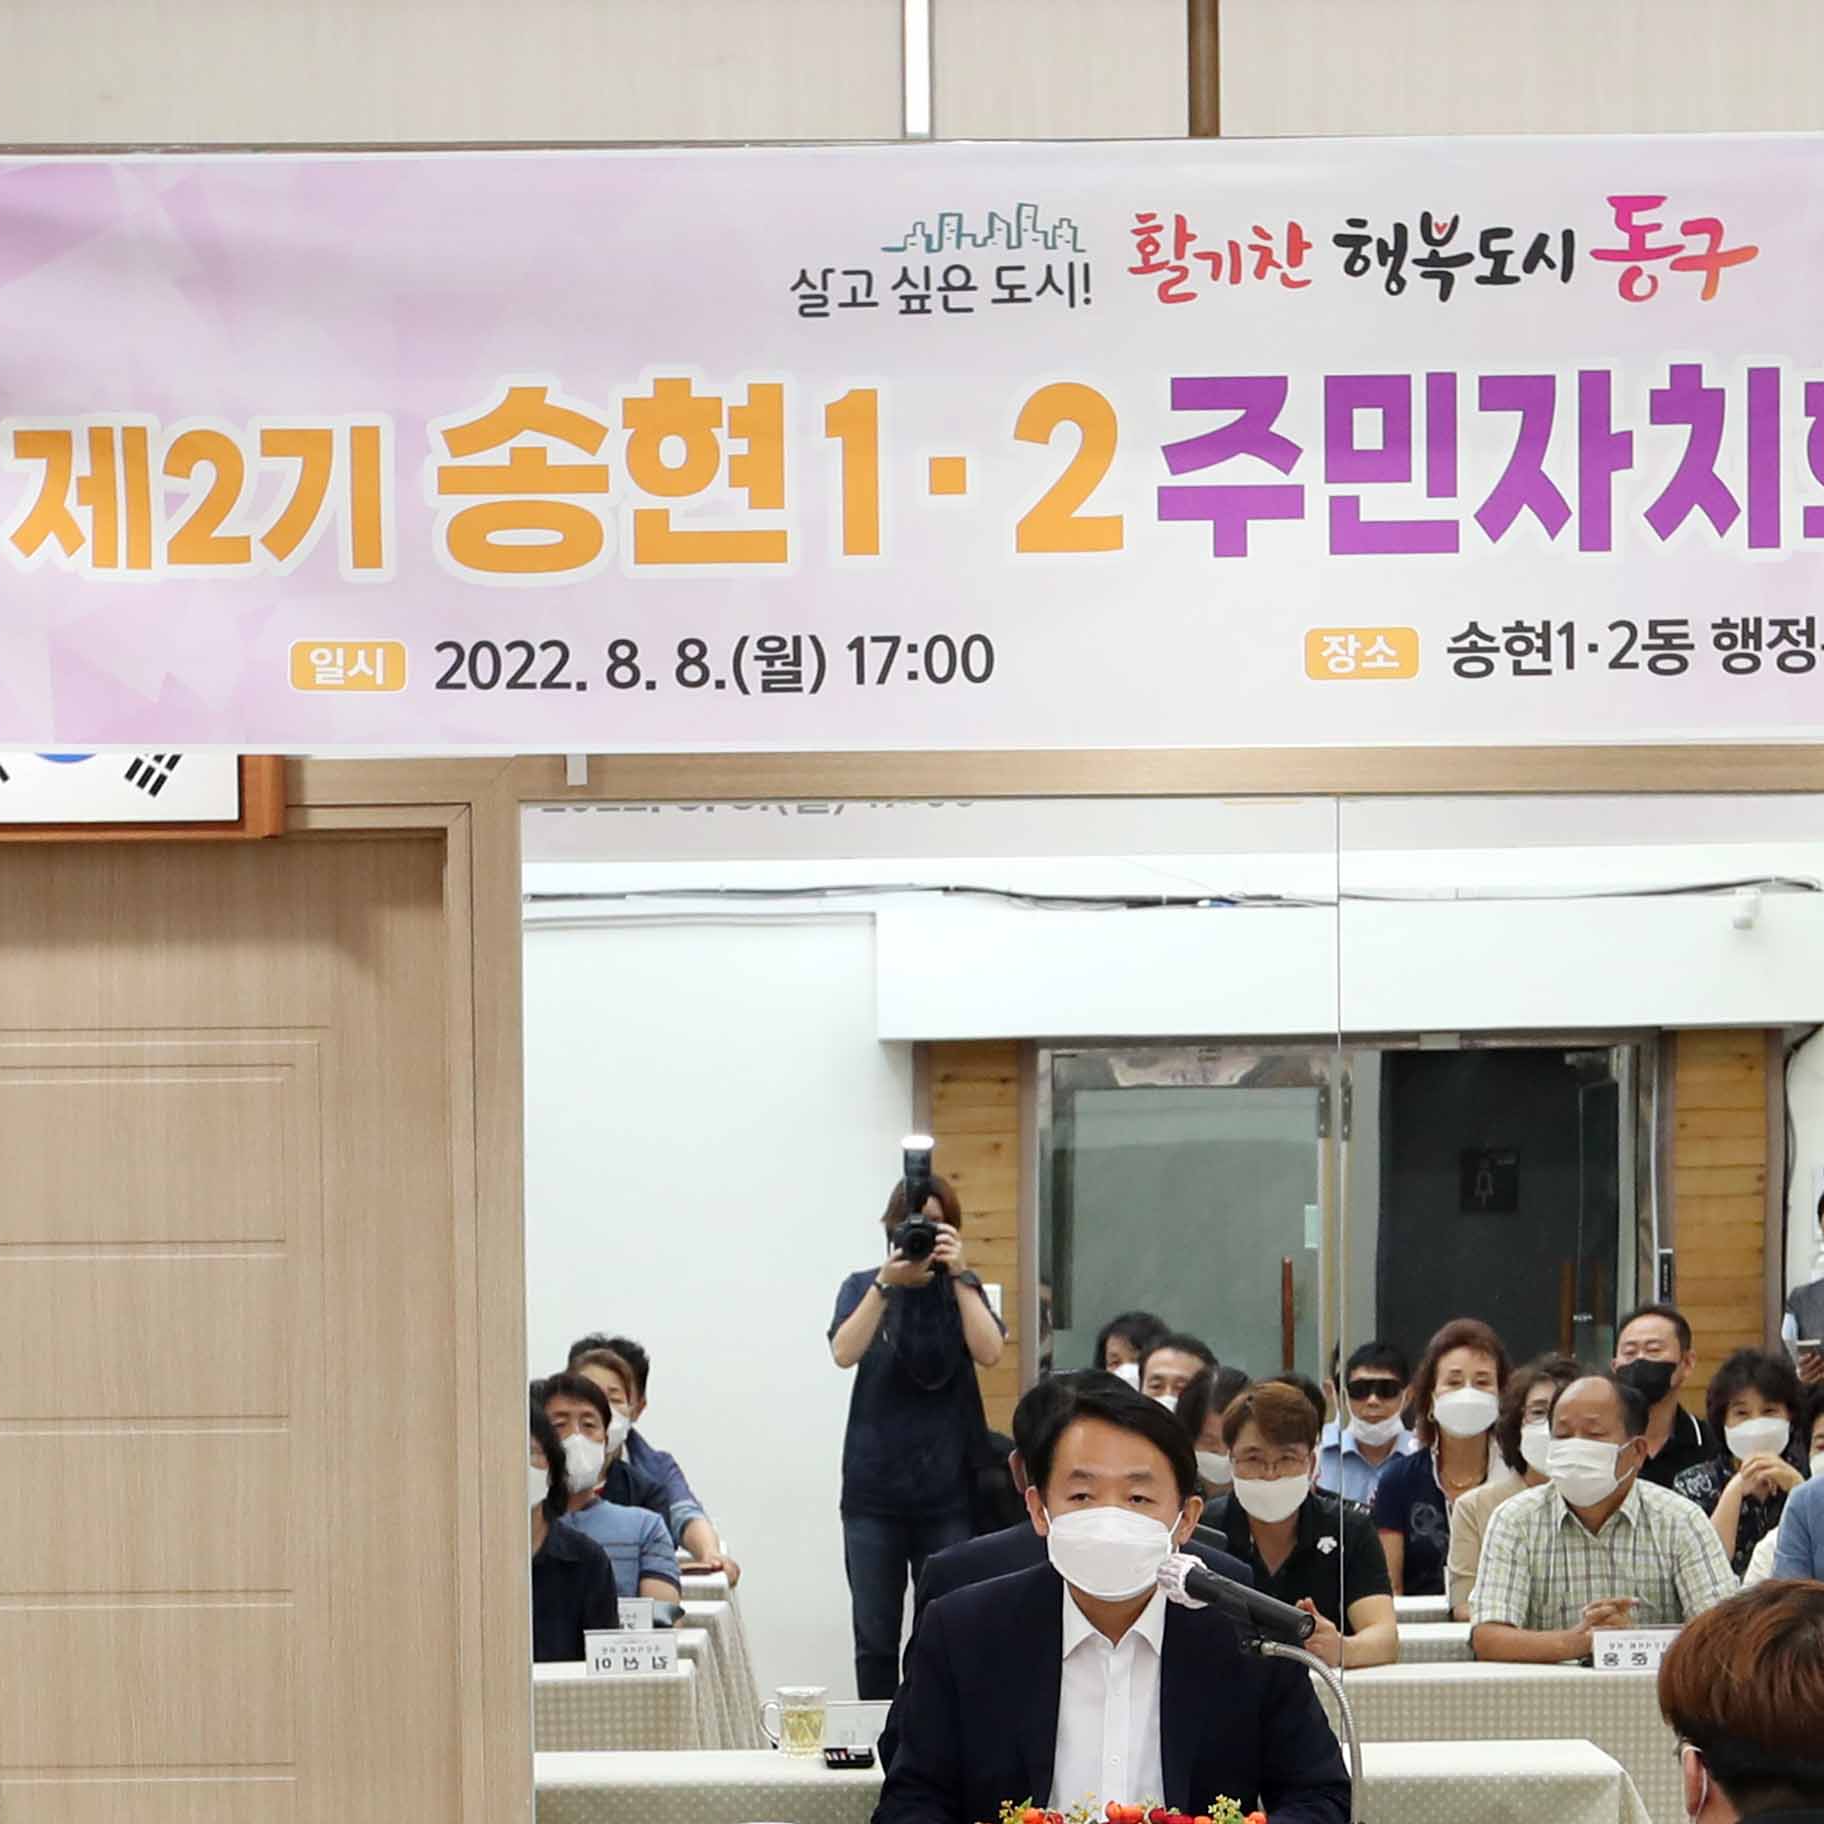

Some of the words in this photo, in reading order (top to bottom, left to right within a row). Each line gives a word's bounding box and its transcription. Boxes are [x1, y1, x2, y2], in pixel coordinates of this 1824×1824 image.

[1129, 212, 1313, 305] 활기찬
[1332, 211, 1575, 303] 행복도시
[1589, 194, 1760, 303] 동구
[790, 267, 879, 318] 살고
[891, 263, 979, 315] 싶은
[991, 261, 1092, 309] 도시!
[12, 426, 382, 569] 제2기
[309, 647, 384, 685] 일시
[434, 639, 587, 692] 2022.
[606, 638, 657, 691] 8.
[675, 634, 826, 696] 8.(월)
[847, 633, 995, 686] 17:00
[1320, 633, 1400, 674] 장소
[1447, 618, 1696, 679] 송현1·2동
